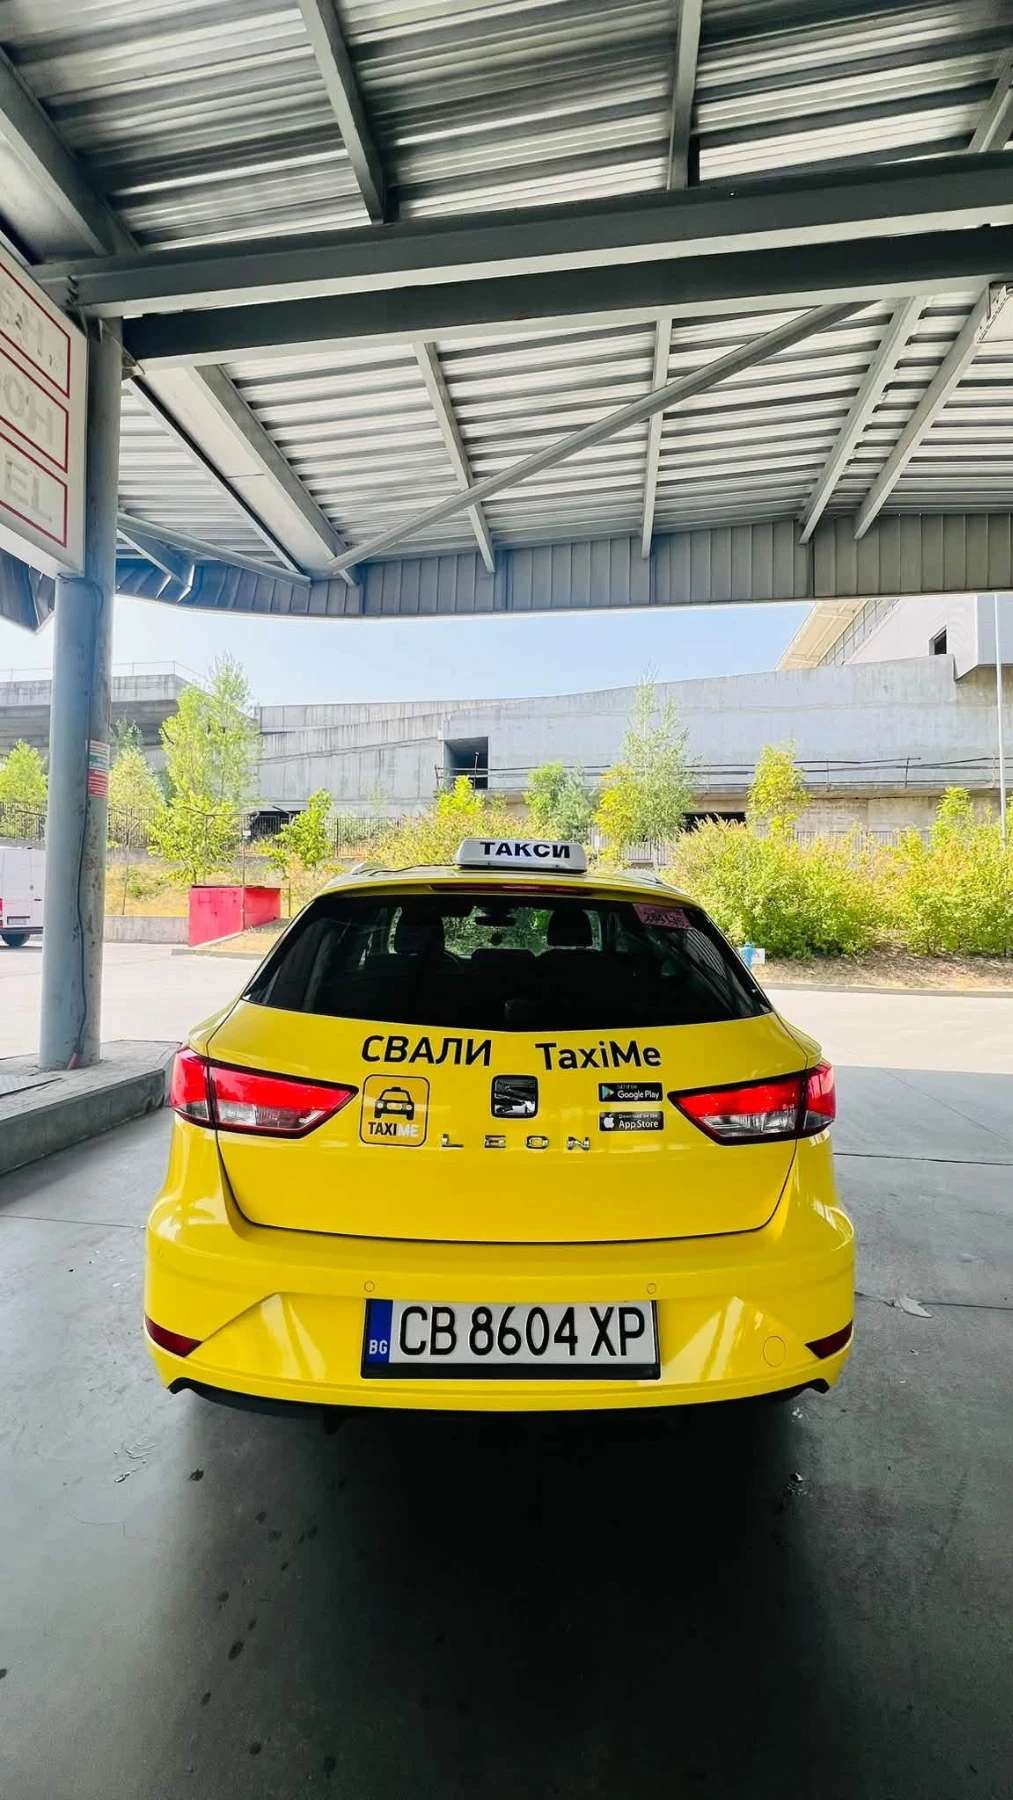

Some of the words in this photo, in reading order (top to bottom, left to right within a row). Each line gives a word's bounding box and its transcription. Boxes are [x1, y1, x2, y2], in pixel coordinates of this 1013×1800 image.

[480, 842, 570, 858] ТАКСИ
[361, 1035, 492, 1066] СВАЛИ
[535, 1040, 661, 1070] TaxiMe
[617, 1090, 644, 1100] Google
[644, 1090, 660, 1100] Play
[618, 1120, 637, 1130] App
[636, 1120, 659, 1128] Store
[441, 1133, 591, 1151] LEON
[399, 1306, 457, 1356] CB
[469, 1306, 579, 1356] 8604
[589, 1306, 645, 1357] XP
[369, 1339, 388, 1355] BG
